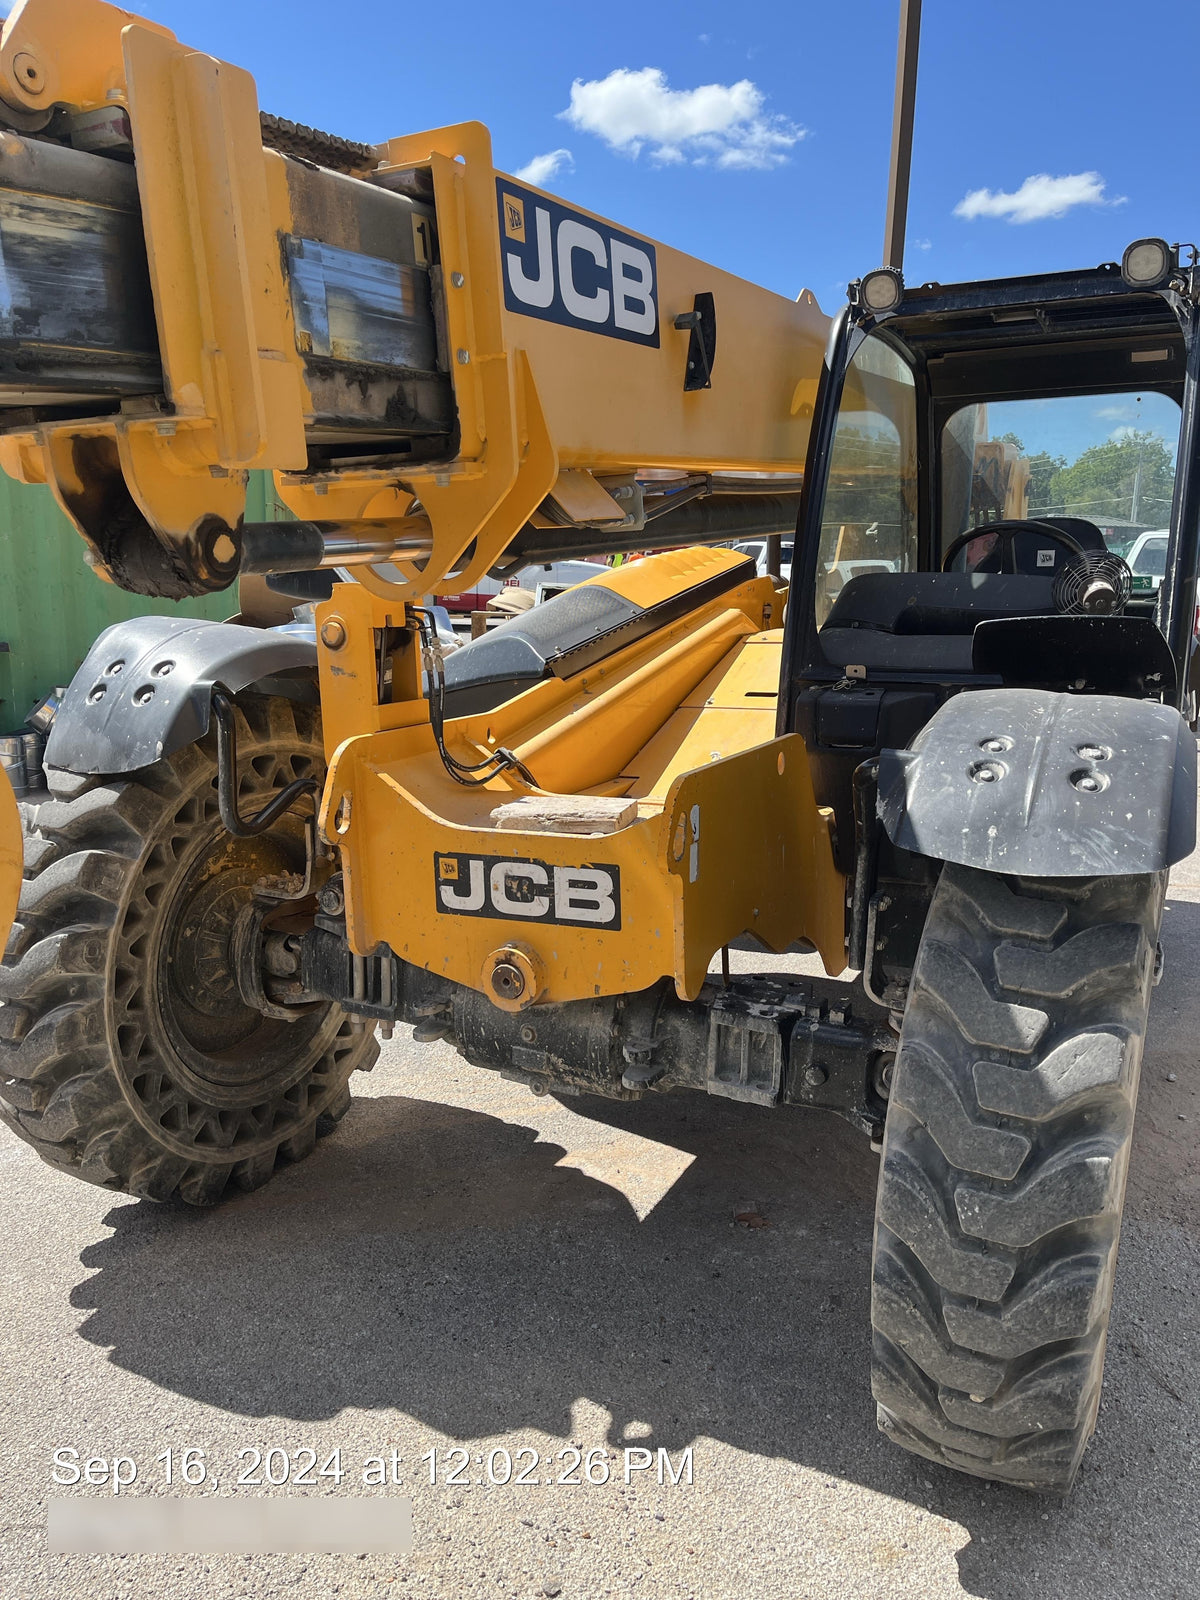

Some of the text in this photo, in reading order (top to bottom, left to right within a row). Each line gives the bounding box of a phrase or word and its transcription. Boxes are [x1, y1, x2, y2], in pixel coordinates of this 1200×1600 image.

[416, 222, 428, 260] 1
[507, 206, 656, 336] JCB
[440, 860, 616, 923] JCB
